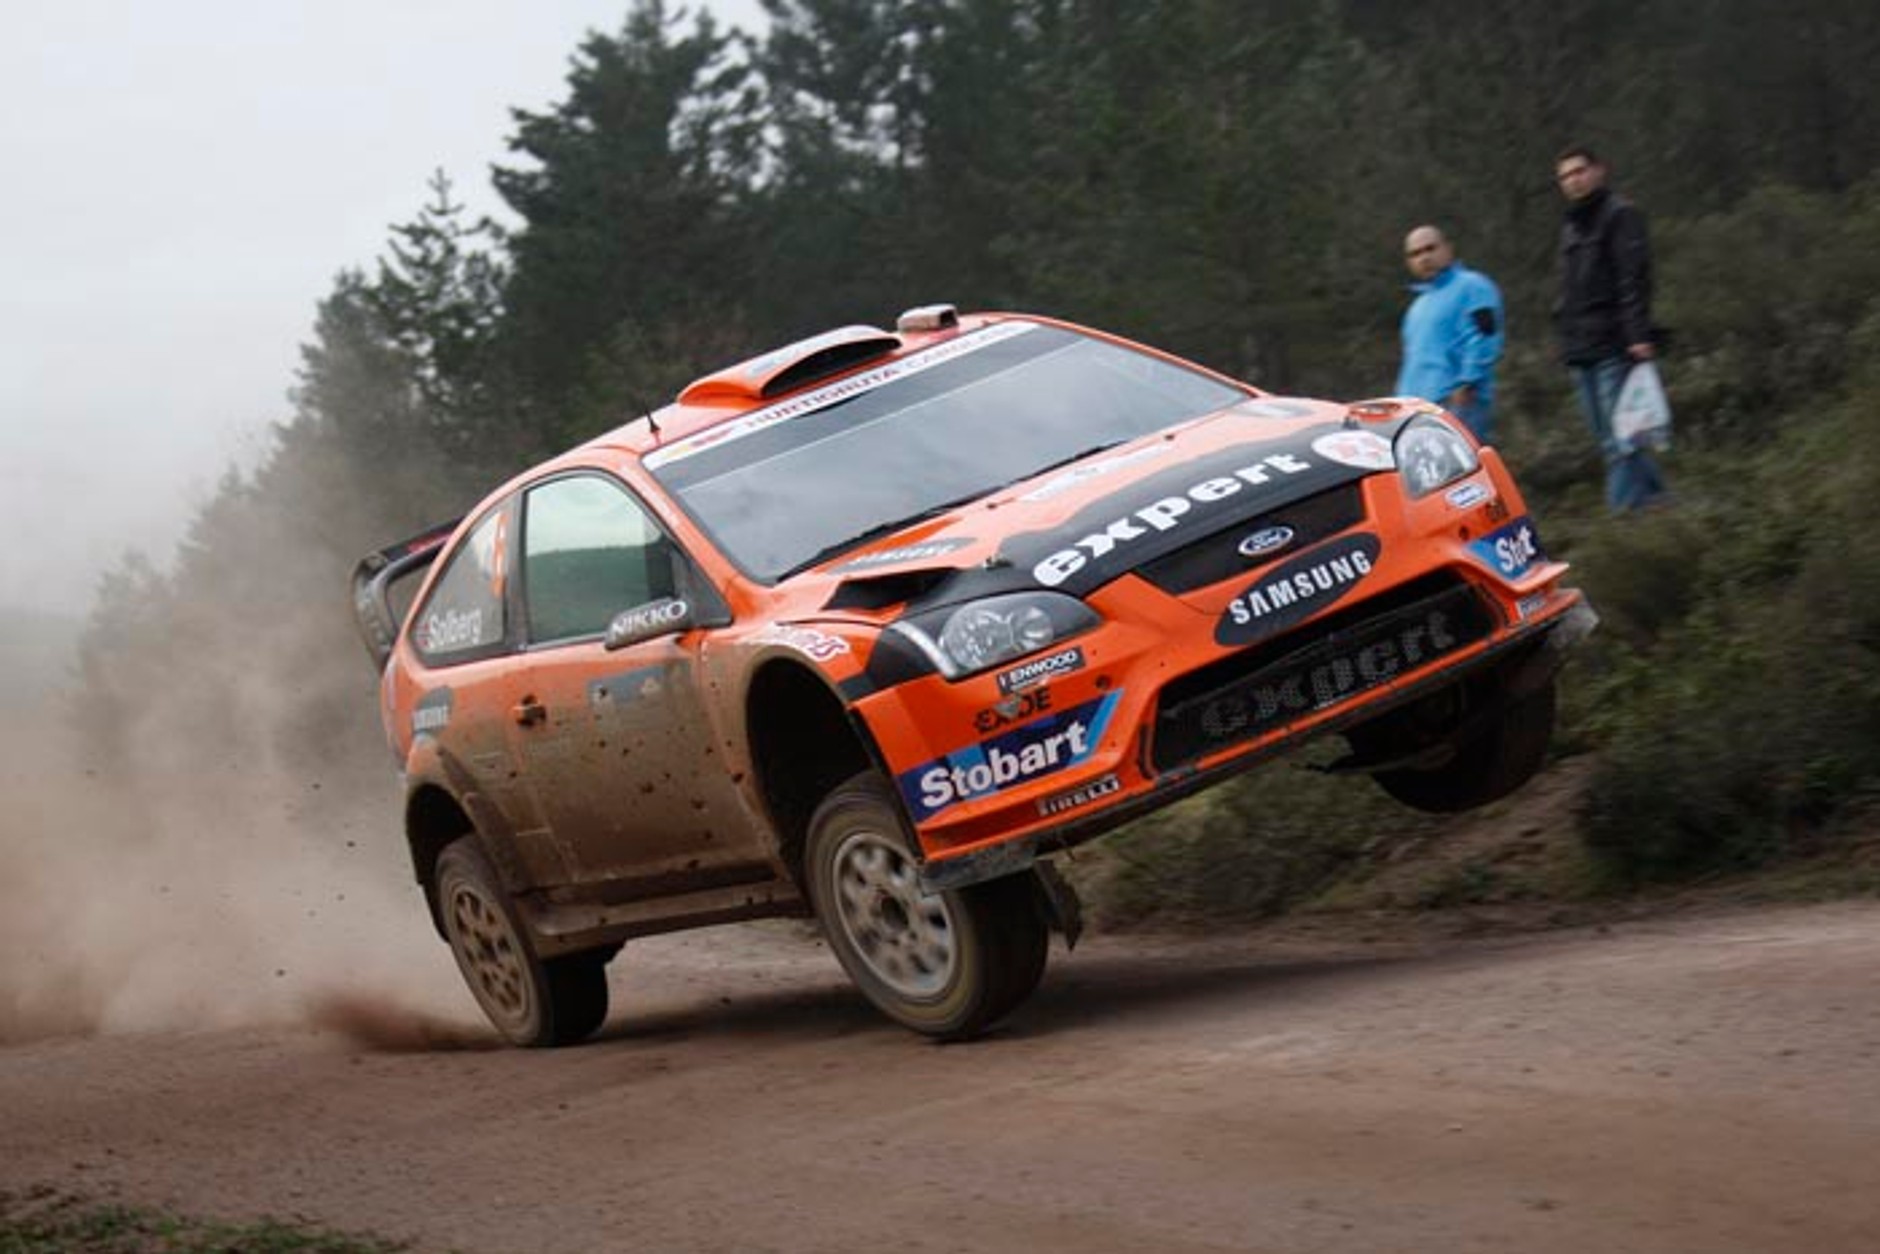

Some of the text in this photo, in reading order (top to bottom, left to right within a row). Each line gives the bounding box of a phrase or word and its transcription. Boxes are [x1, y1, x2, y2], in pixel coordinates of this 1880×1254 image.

[1033, 454, 1310, 586] expert
[608, 600, 687, 641] NIKKO
[1228, 551, 1371, 624] SAMSUNG
[429, 607, 481, 648] Solberg
[1201, 611, 1454, 735] expert
[974, 688, 1051, 733] EDE
[921, 720, 1088, 807] Stobart
